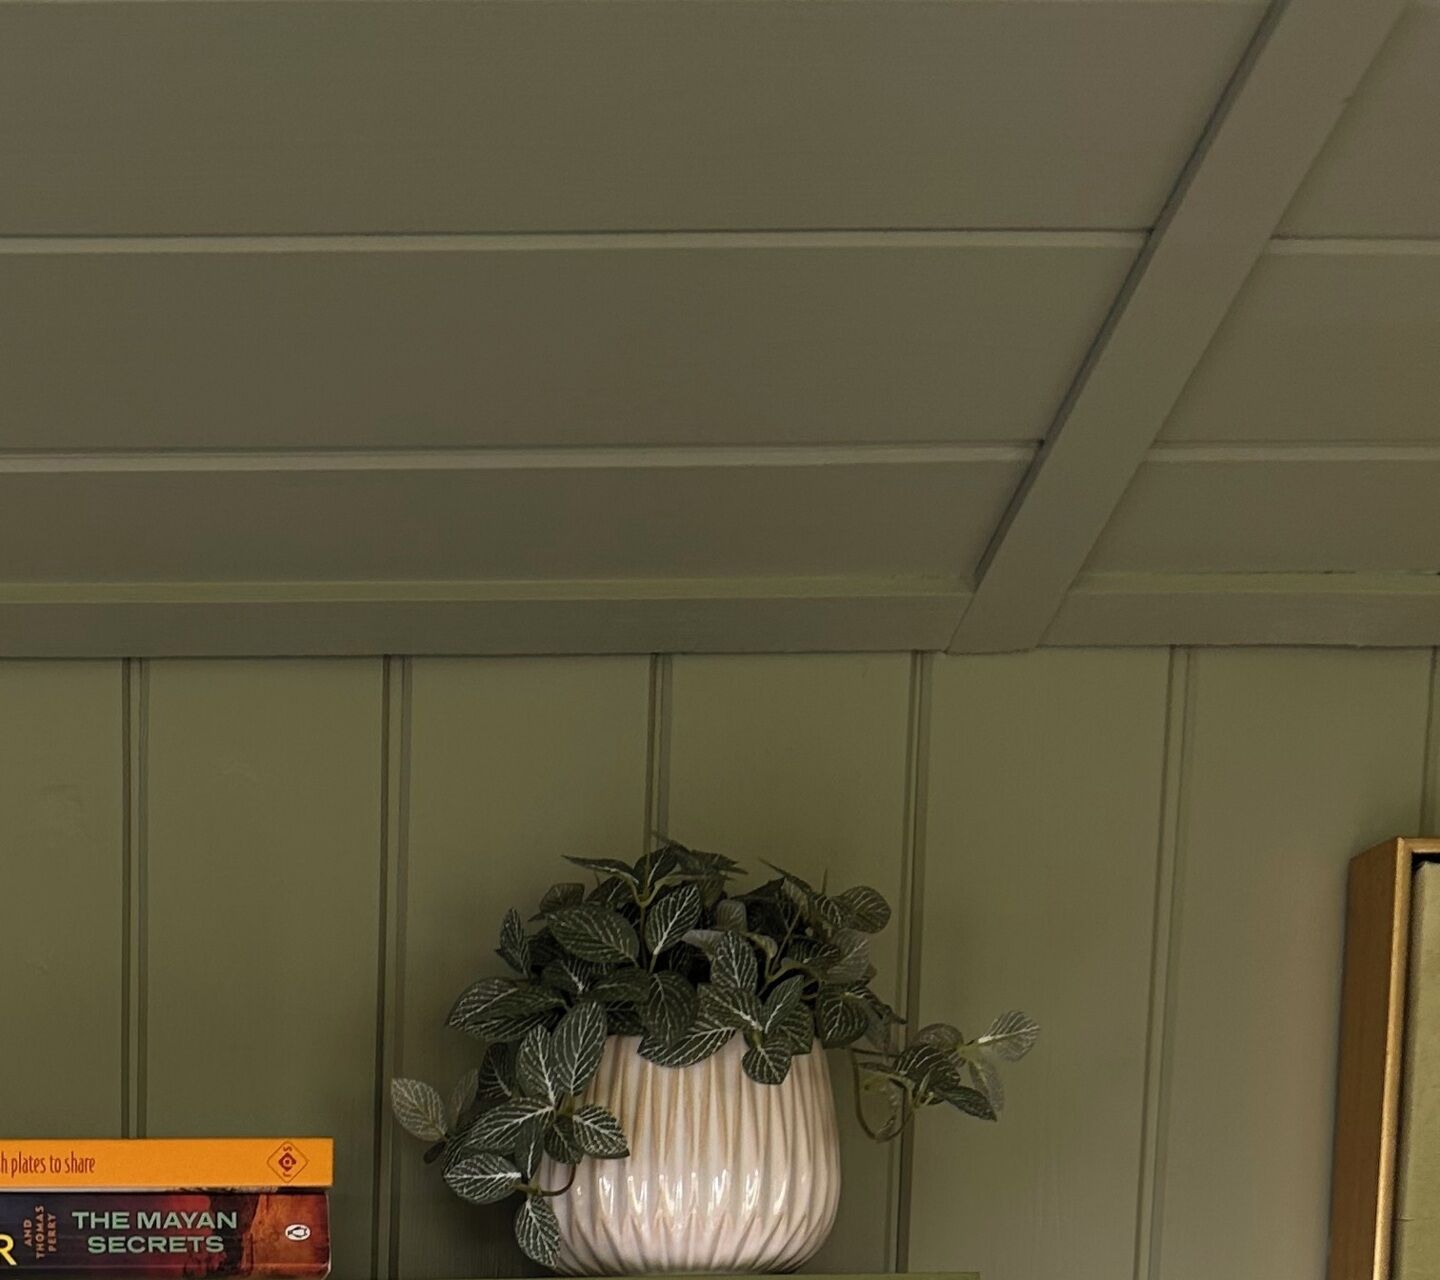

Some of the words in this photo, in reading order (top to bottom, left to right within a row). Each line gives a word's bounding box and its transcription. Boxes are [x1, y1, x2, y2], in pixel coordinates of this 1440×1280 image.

[10, 1150, 47, 1179] plates
[49, 1154, 62, 1174] to
[64, 1150, 96, 1174] share
[23, 1218, 33, 1247] AND
[34, 1204, 46, 1260] THOMAS
[47, 1212, 58, 1253] PERRY
[71, 1211, 131, 1230] THE
[136, 1211, 238, 1230] MAYAN
[87, 1235, 225, 1254] SECRETS
